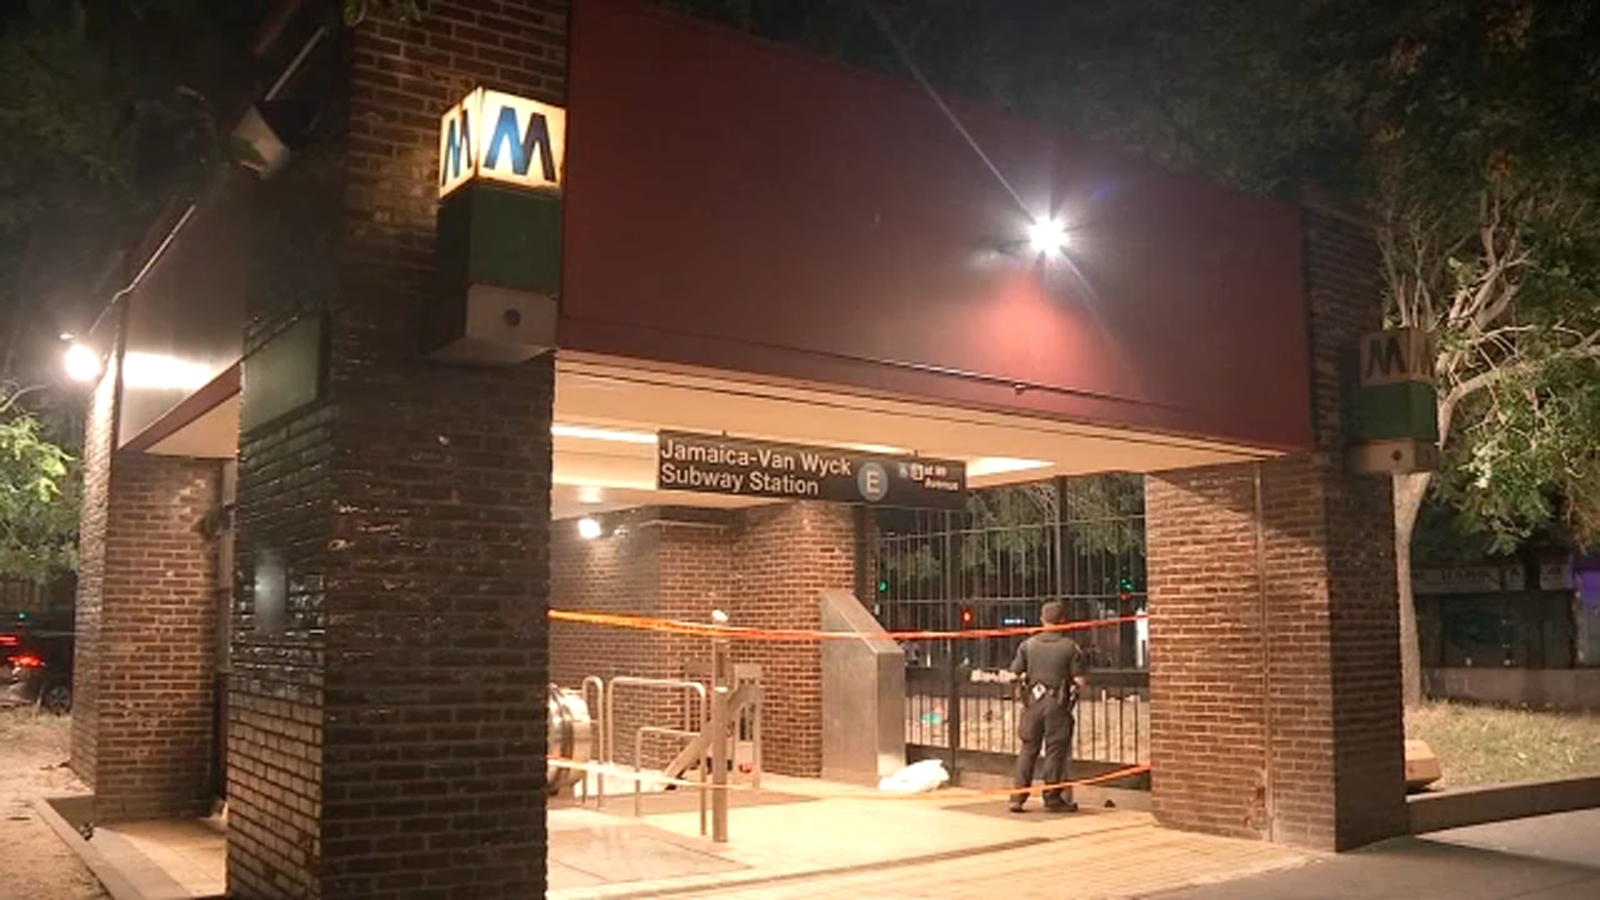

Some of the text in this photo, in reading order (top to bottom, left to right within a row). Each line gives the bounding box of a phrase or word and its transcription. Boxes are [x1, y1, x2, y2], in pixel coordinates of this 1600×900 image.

[442, 108, 472, 187] M
[483, 105, 557, 183] M
[1366, 338, 1406, 378] M
[661, 439, 851, 478] Jamaica-Van Wyck
[661, 462, 818, 495] Subway Station
[865, 470, 881, 494] E
